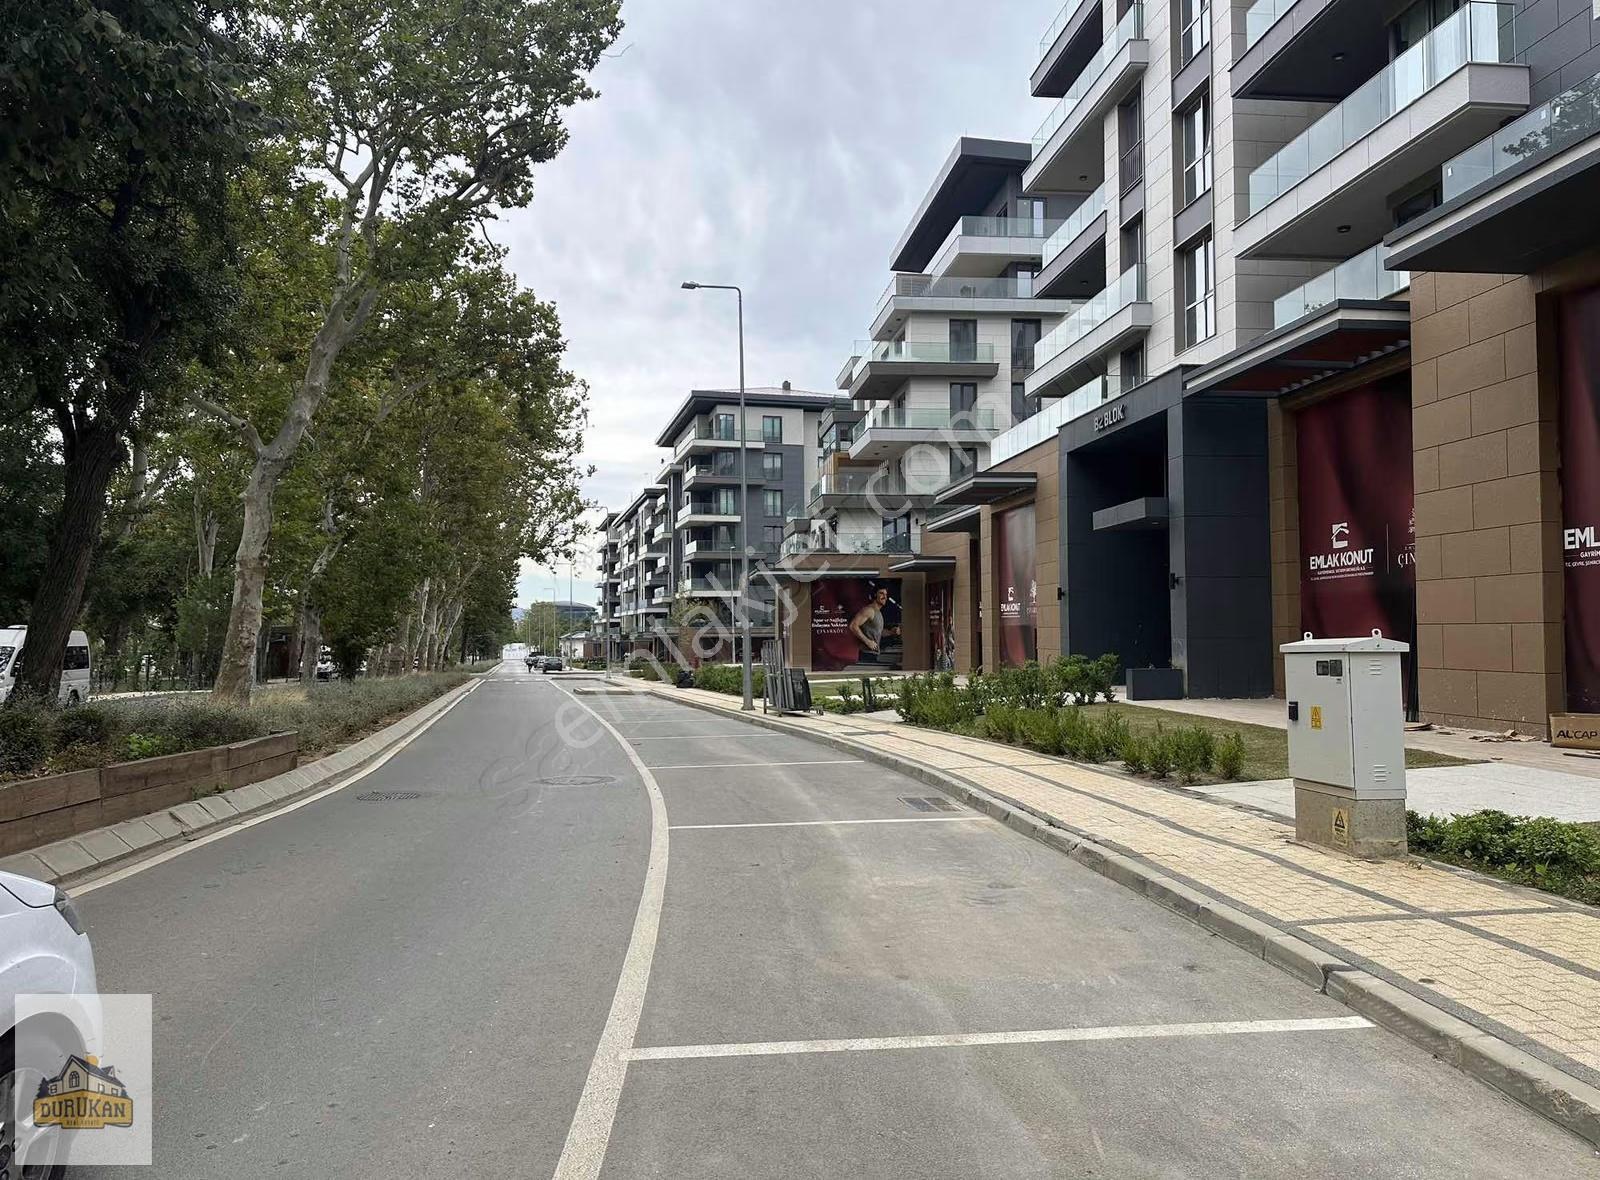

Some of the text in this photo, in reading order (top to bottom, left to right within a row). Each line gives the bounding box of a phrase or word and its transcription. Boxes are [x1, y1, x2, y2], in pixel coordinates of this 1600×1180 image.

[1104, 405, 1125, 427] BLOK
[1310, 548, 1374, 570] EMLAK KONUT
